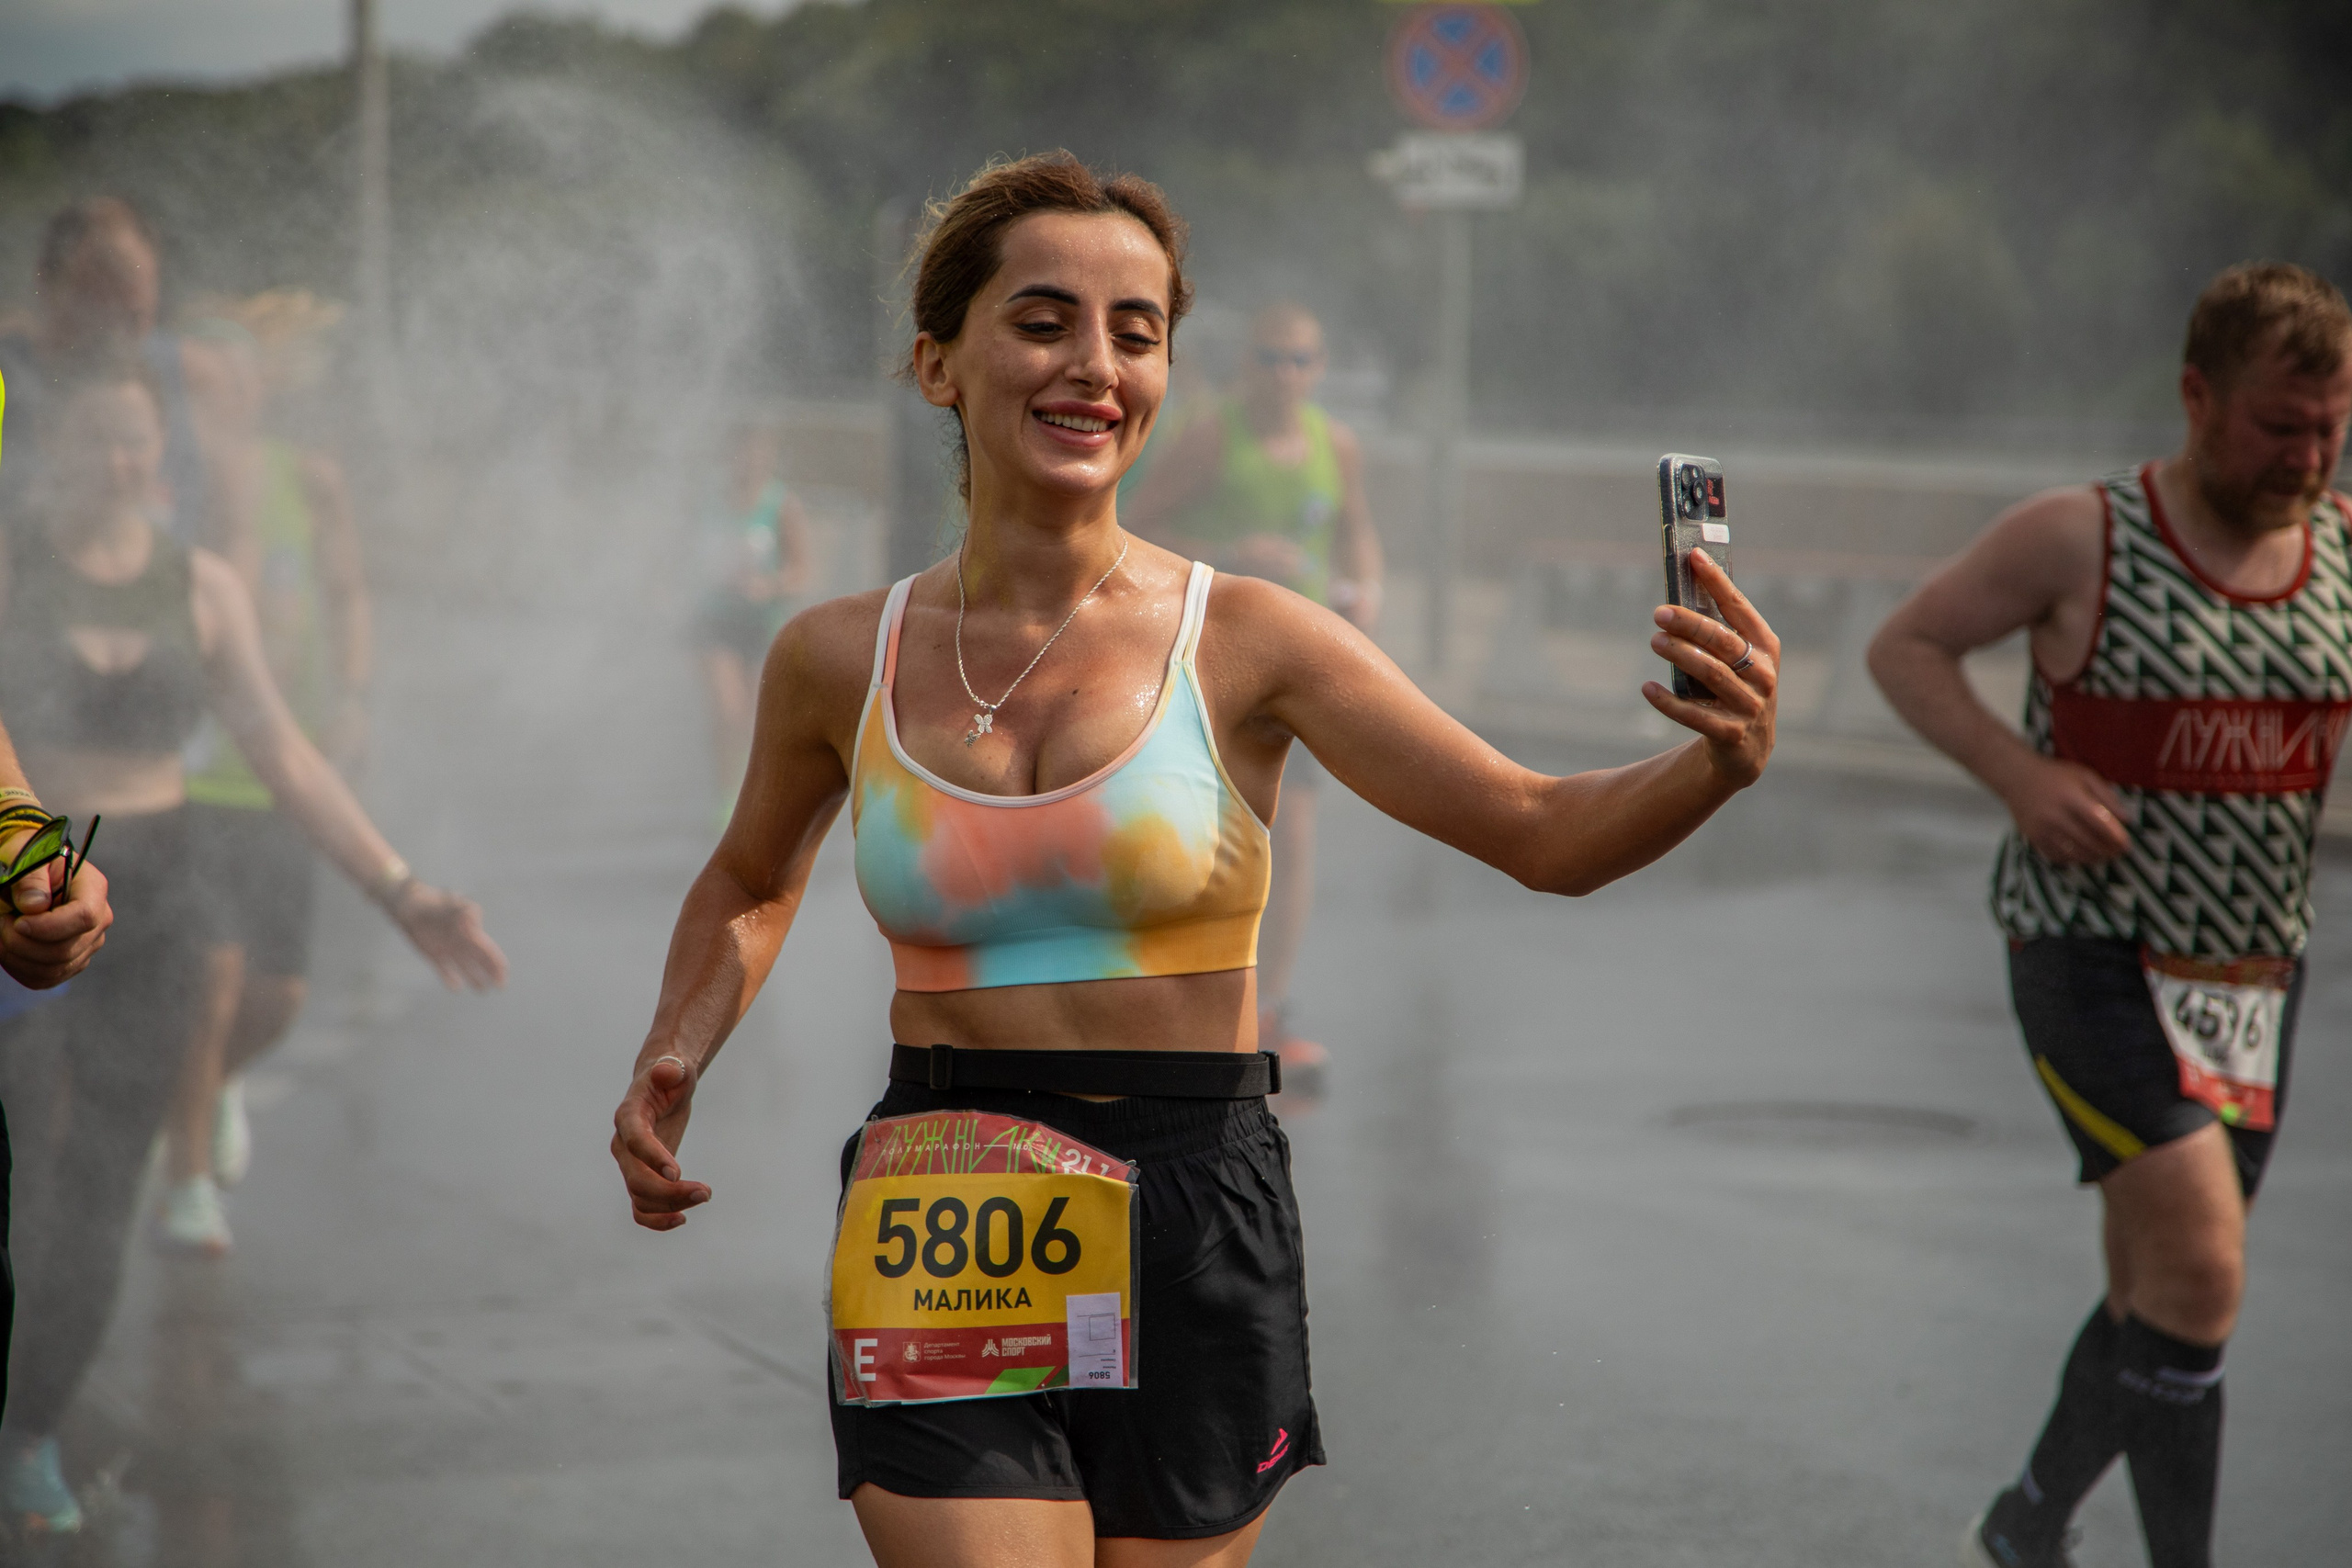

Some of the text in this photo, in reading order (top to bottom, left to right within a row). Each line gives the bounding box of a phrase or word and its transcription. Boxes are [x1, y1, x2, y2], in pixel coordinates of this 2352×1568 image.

[875, 1196, 1082, 1279] 5806
[913, 1287, 1033, 1312] МАЛИКА
[1001, 1334, 1052, 1348] МОСКОВСКИЙ
[1001, 1347, 1025, 1357] СПОРТ
[1089, 1371, 1111, 1380] 5806
